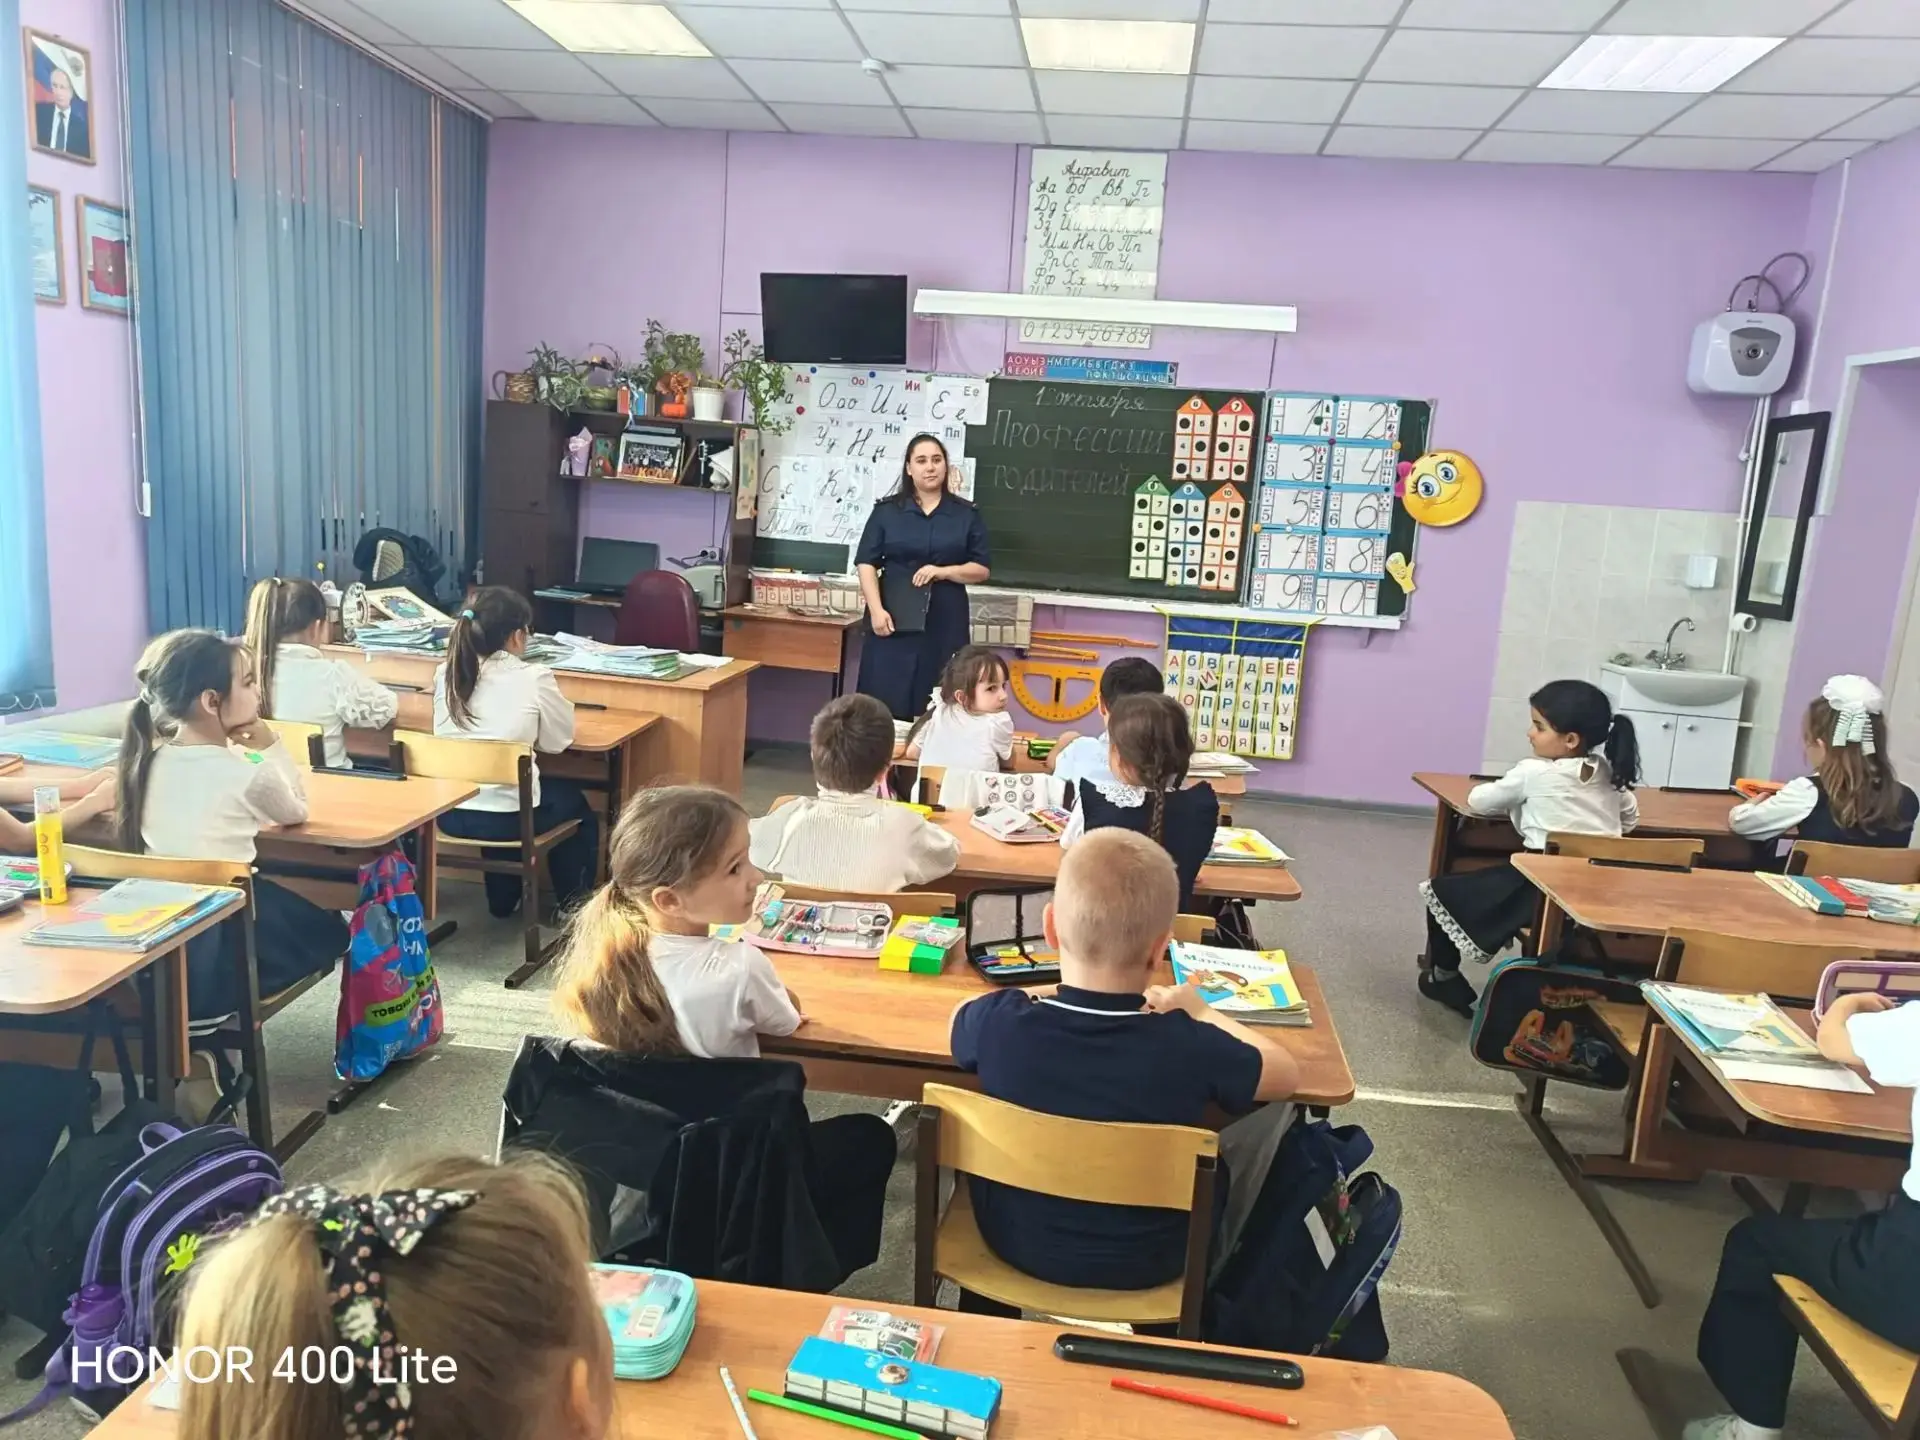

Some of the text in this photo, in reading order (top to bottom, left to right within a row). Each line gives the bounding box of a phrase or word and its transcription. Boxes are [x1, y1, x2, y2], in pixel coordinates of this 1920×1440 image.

[1062, 159, 1131, 178] Алфавит
[1036, 176, 1151, 197] Аа Бб Вв Гг
[1100, 234, 1115, 251] Оо
[796, 374, 810, 384] Аа
[851, 376, 865, 386] Оо
[905, 380, 920, 391] Ии
[963, 386, 980, 397] Ее
[1036, 386, 1145, 418] 1 октября
[884, 423, 901, 434] Нн
[1273, 420, 1280, 433] 1
[1336, 421, 1346, 436] 2
[1363, 402, 1388, 439] 2
[945, 427, 960, 438] Пп
[1265, 444, 1381, 485] 3 3 4 4
[1262, 490, 1381, 529] 5 5 6 6
[1260, 534, 1374, 573] 7 7 8 8
[1253, 574, 1365, 614] 9 9 0 0
[1169, 655, 1179, 667] А
[1187, 654, 1197, 666] б
[1208, 658, 1217, 669] В
[1266, 663, 1274, 674] Е
[1286, 661, 1295, 675] Ё
[1168, 674, 1178, 685] Ж
[1201, 670, 1213, 684] И
[1262, 682, 1273, 693] Л
[1282, 683, 1294, 695] М
[1184, 694, 1194, 706] О
[1202, 696, 1212, 708] П
[1223, 698, 1232, 709] Р
[1201, 714, 1209, 727] Ц
[1217, 735, 1229, 747] Ю
